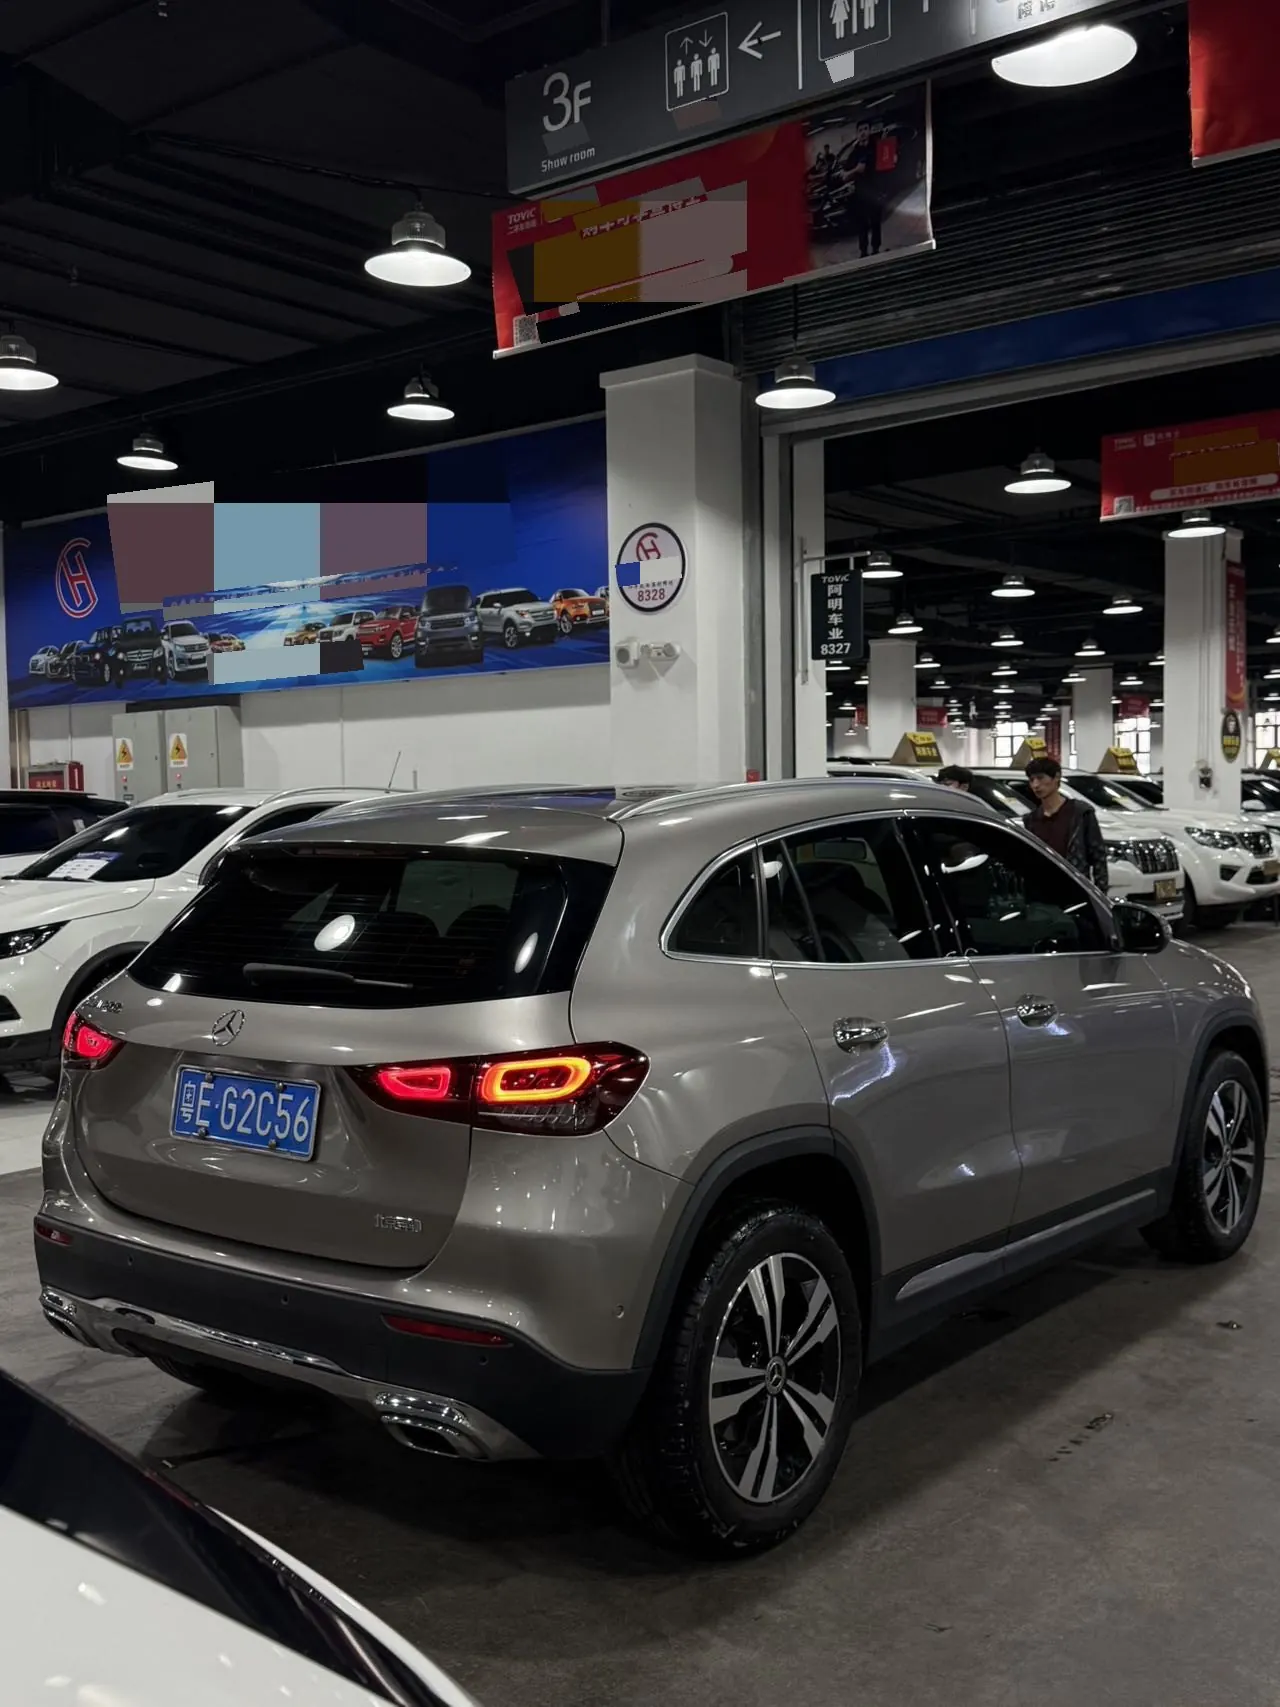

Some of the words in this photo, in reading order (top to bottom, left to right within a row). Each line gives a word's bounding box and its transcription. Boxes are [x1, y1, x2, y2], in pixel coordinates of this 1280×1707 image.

[543, 72, 591, 131] 3F
[541, 155, 568, 172] Show
[570, 147, 596, 164] room
[507, 207, 537, 225] TOVIC
[821, 573, 850, 584] TOVIC
[637, 588, 666, 602] 8328
[827, 584, 844, 640] 阿明车业
[820, 642, 851, 655] 8327
